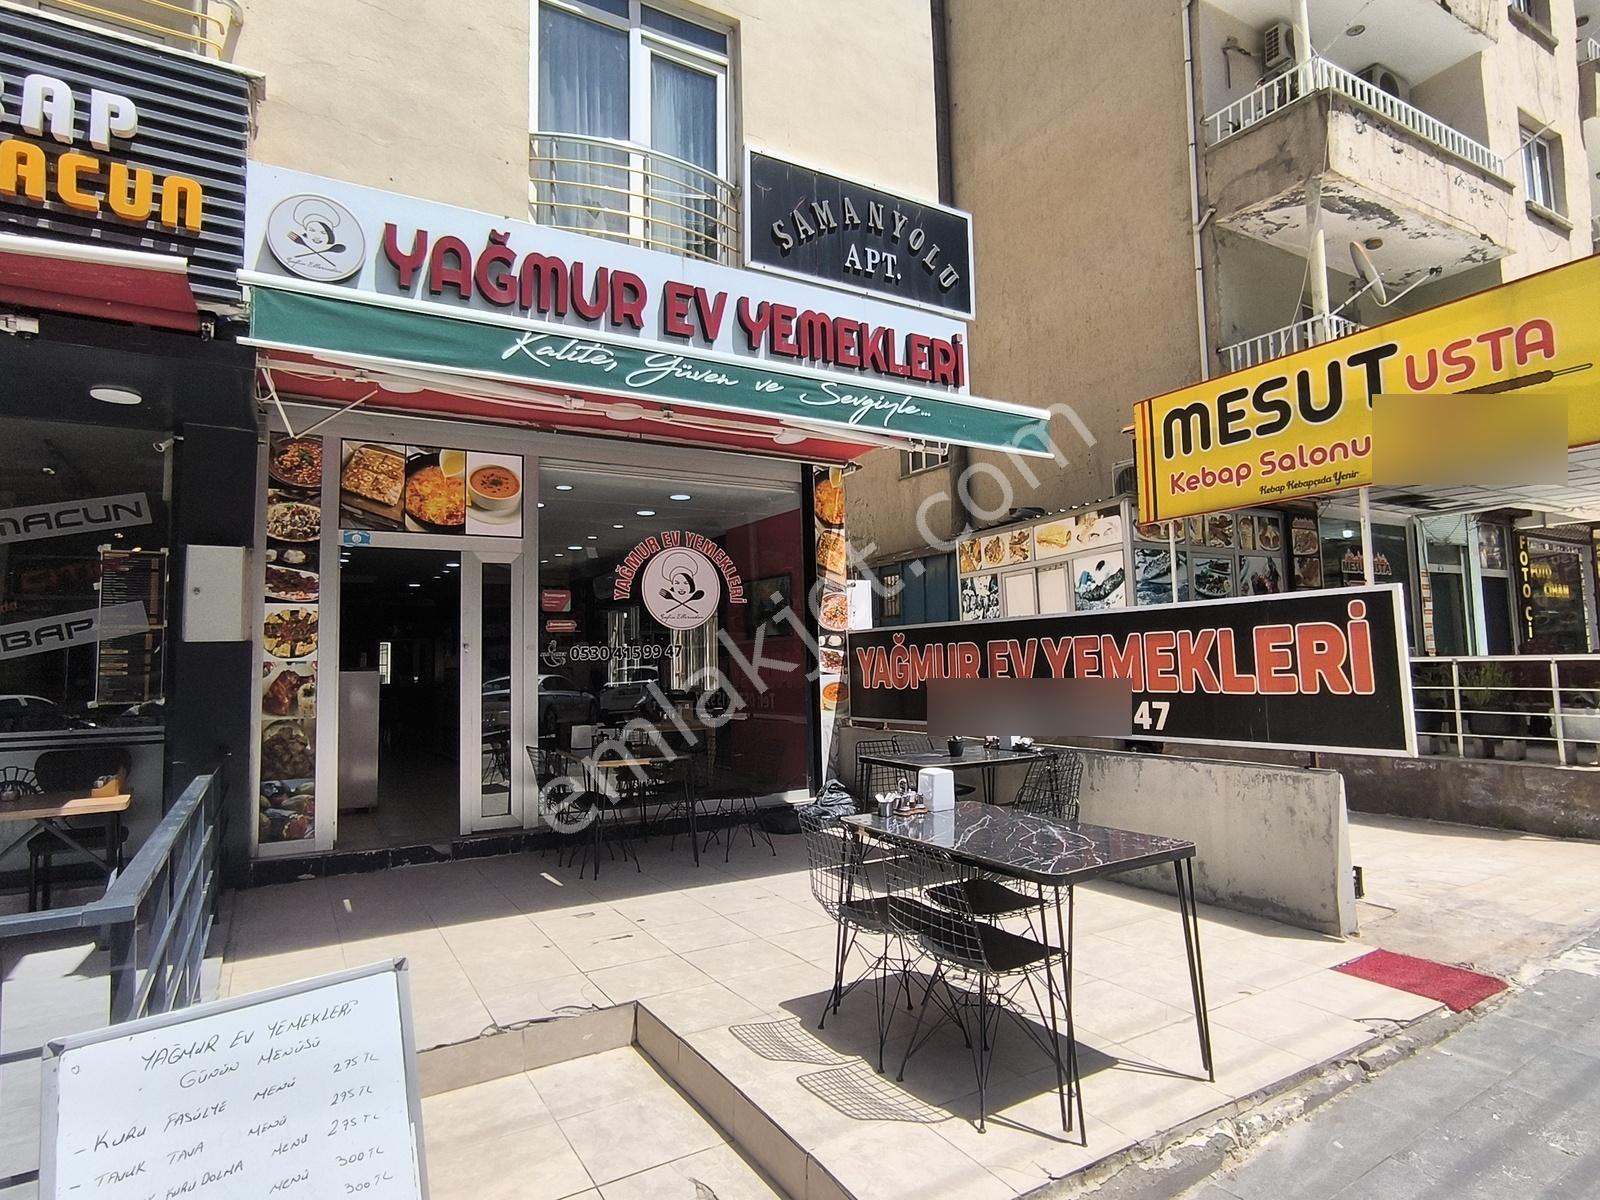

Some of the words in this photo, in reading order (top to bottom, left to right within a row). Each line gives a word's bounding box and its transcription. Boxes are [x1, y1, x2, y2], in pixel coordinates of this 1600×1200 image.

[0, 73, 138, 151] AP
[772, 197, 960, 288] SAMANYOLU
[845, 244, 902, 280] APT.
[384, 222, 648, 330] YAĞMUR
[664, 280, 728, 342] EV
[737, 296, 965, 387] YEMEKLERİ
[501, 331, 618, 372] Kalite,
[625, 352, 740, 388] Güven
[755, 377, 784, 393] ve
[799, 381, 932, 426] Sevgiyle...
[1162, 343, 1398, 459] MESUT
[1405, 318, 1556, 392] USTA
[1170, 462, 1252, 495] Kebap
[1260, 436, 1372, 477] Salonu
[1259, 485, 1285, 495] Kebap
[1333, 470, 1359, 485] Yenir
[614, 536, 660, 600] YAĞMUR
[661, 531, 680, 547] EV
[685, 531, 747, 603] YEMEKLERİ
[1520, 536, 1532, 598] FOTO
[570, 645, 609, 660] 0530
[612, 645, 641, 660] 415
[642, 644, 662, 659] 99
[664, 643, 683, 658] 47
[856, 632, 981, 690] YAĞMUR
[987, 638, 1038, 678] EV
[1040, 599, 1376, 695] YEMEKLERİ
[1133, 701, 1170, 731] 47
[141, 1034, 219, 1071] YAĞMUR
[229, 1031, 254, 1048] EV
[94, 1127, 147, 1152] KURU
[332, 1056, 359, 1073] 275
[364, 1052, 380, 1063] TL
[359, 1085, 373, 1097] TL
[335, 1151, 365, 1167] 300
[343, 1181, 371, 1194] 300
